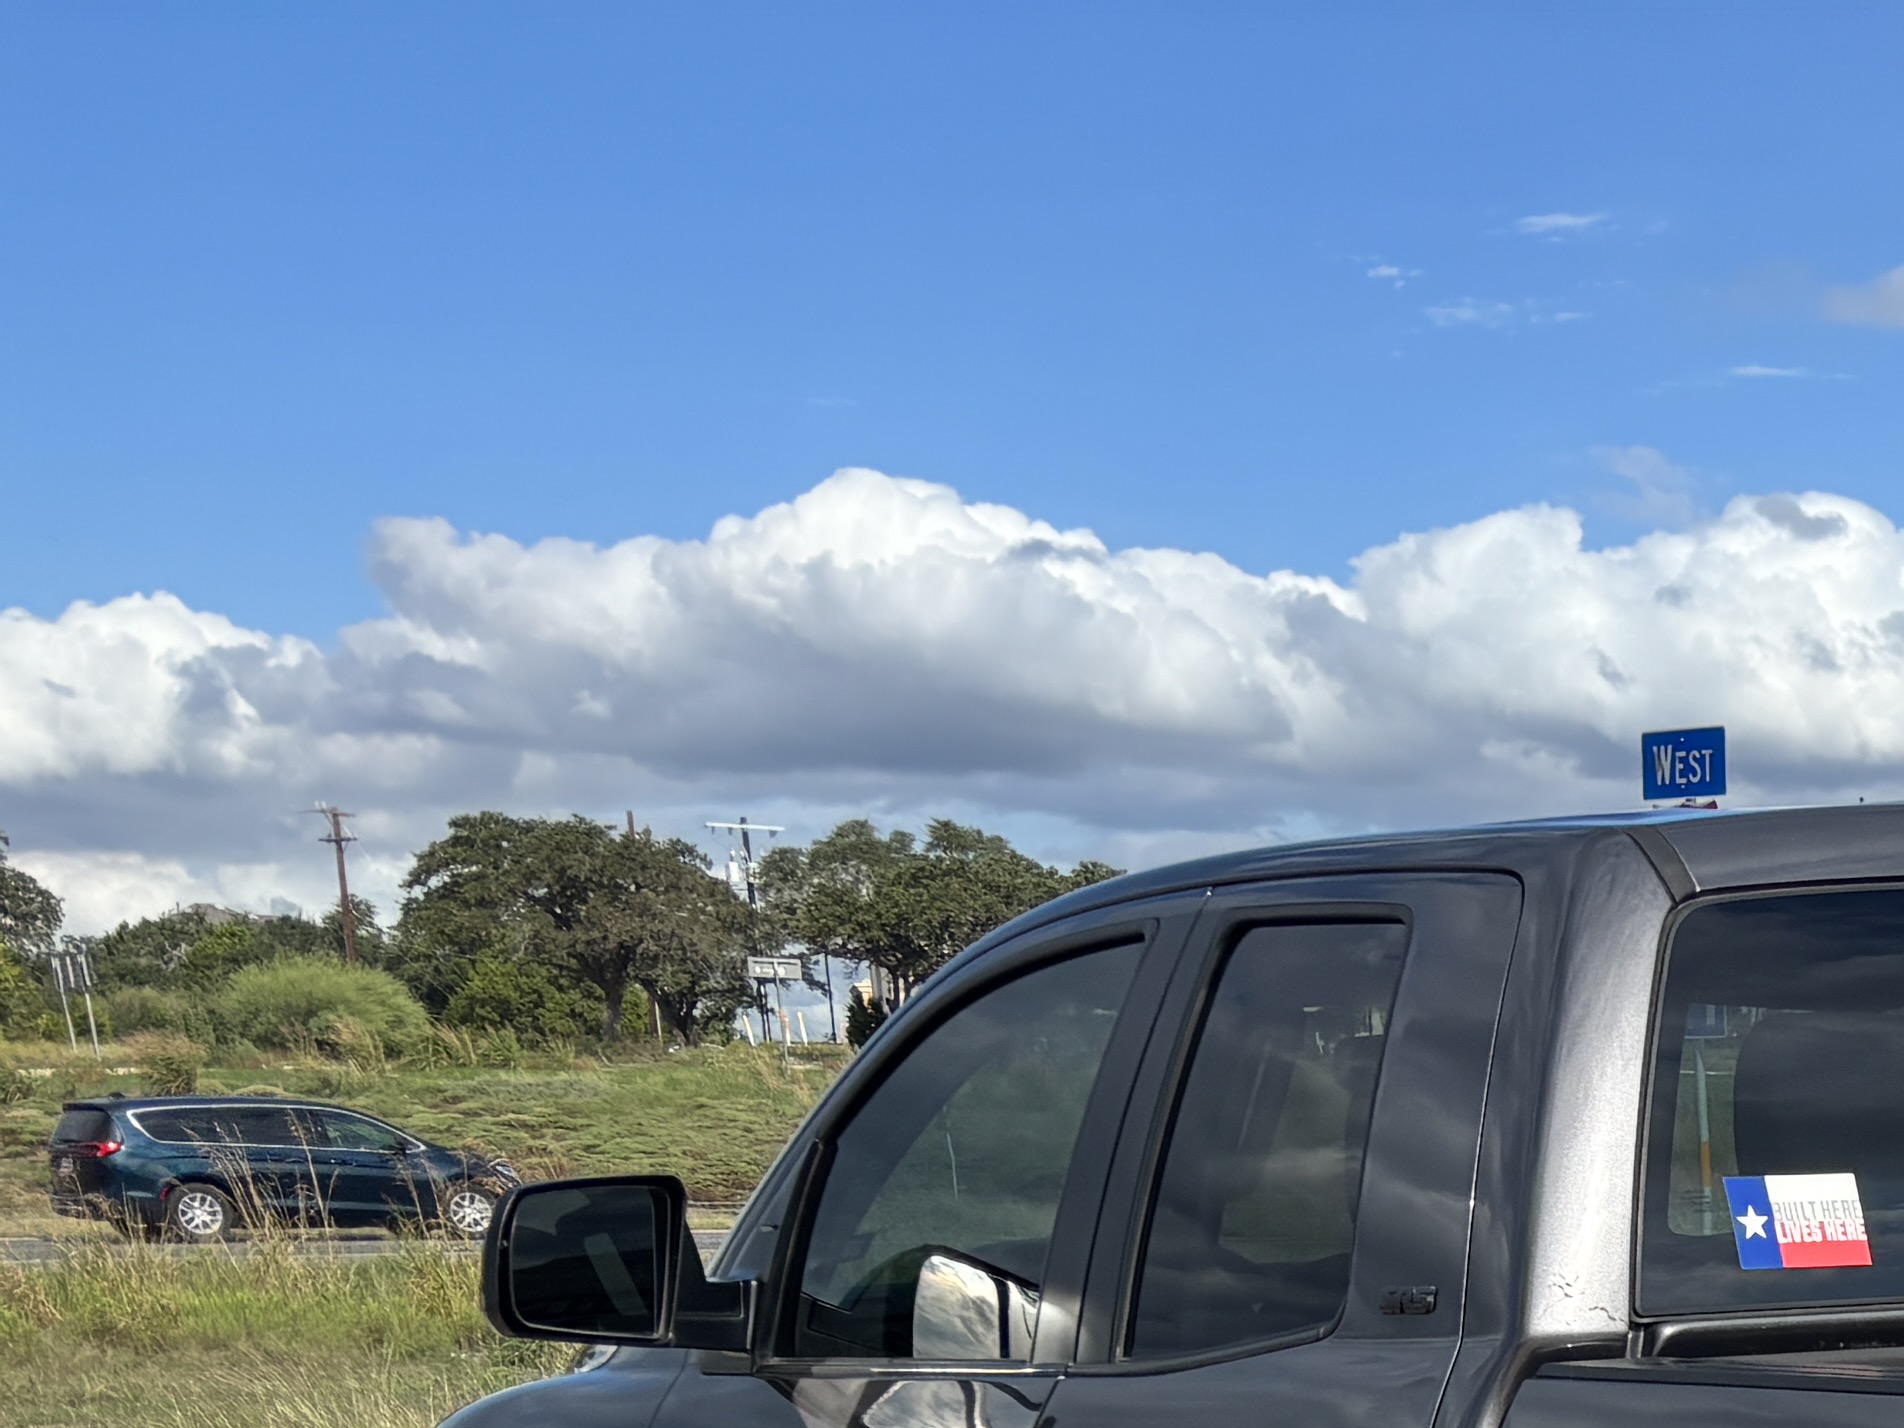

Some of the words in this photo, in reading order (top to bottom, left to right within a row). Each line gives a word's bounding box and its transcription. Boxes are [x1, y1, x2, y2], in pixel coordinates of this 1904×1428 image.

[1772, 1201, 1816, 1221] BUILT
[1820, 1199, 1864, 1219] HERE
[1775, 1220, 1823, 1244] LIVES
[1825, 1218, 1868, 1242] HERE
